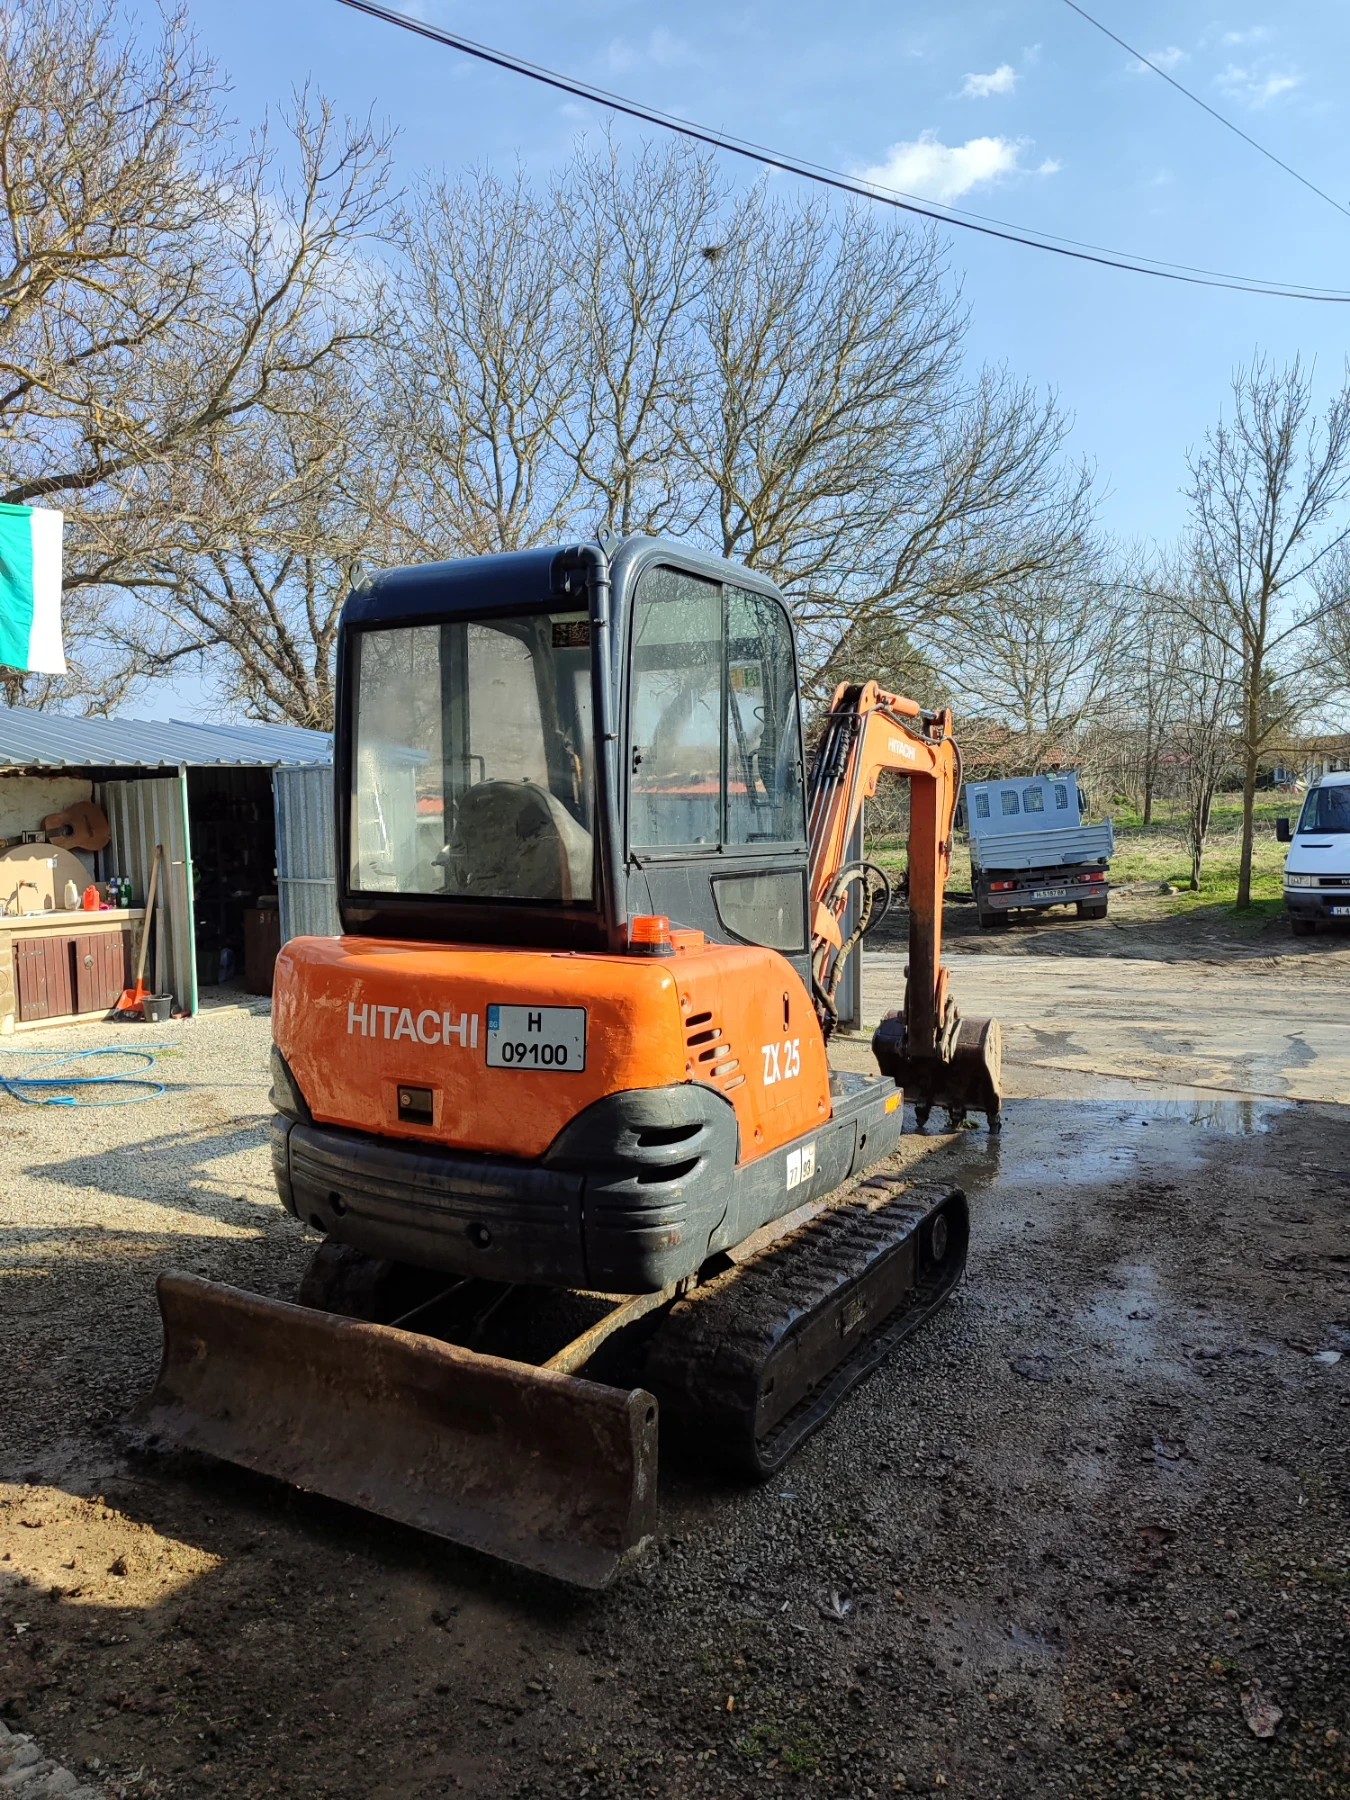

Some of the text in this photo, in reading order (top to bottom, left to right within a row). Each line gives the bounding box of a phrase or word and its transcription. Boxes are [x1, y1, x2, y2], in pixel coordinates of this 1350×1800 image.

[888, 737, 916, 761] HITACHI
[347, 1001, 479, 1049] HITACHI
[528, 1012, 542, 1033] H
[502, 1041, 568, 1066] 09100
[761, 1038, 800, 1086] ZX 25
